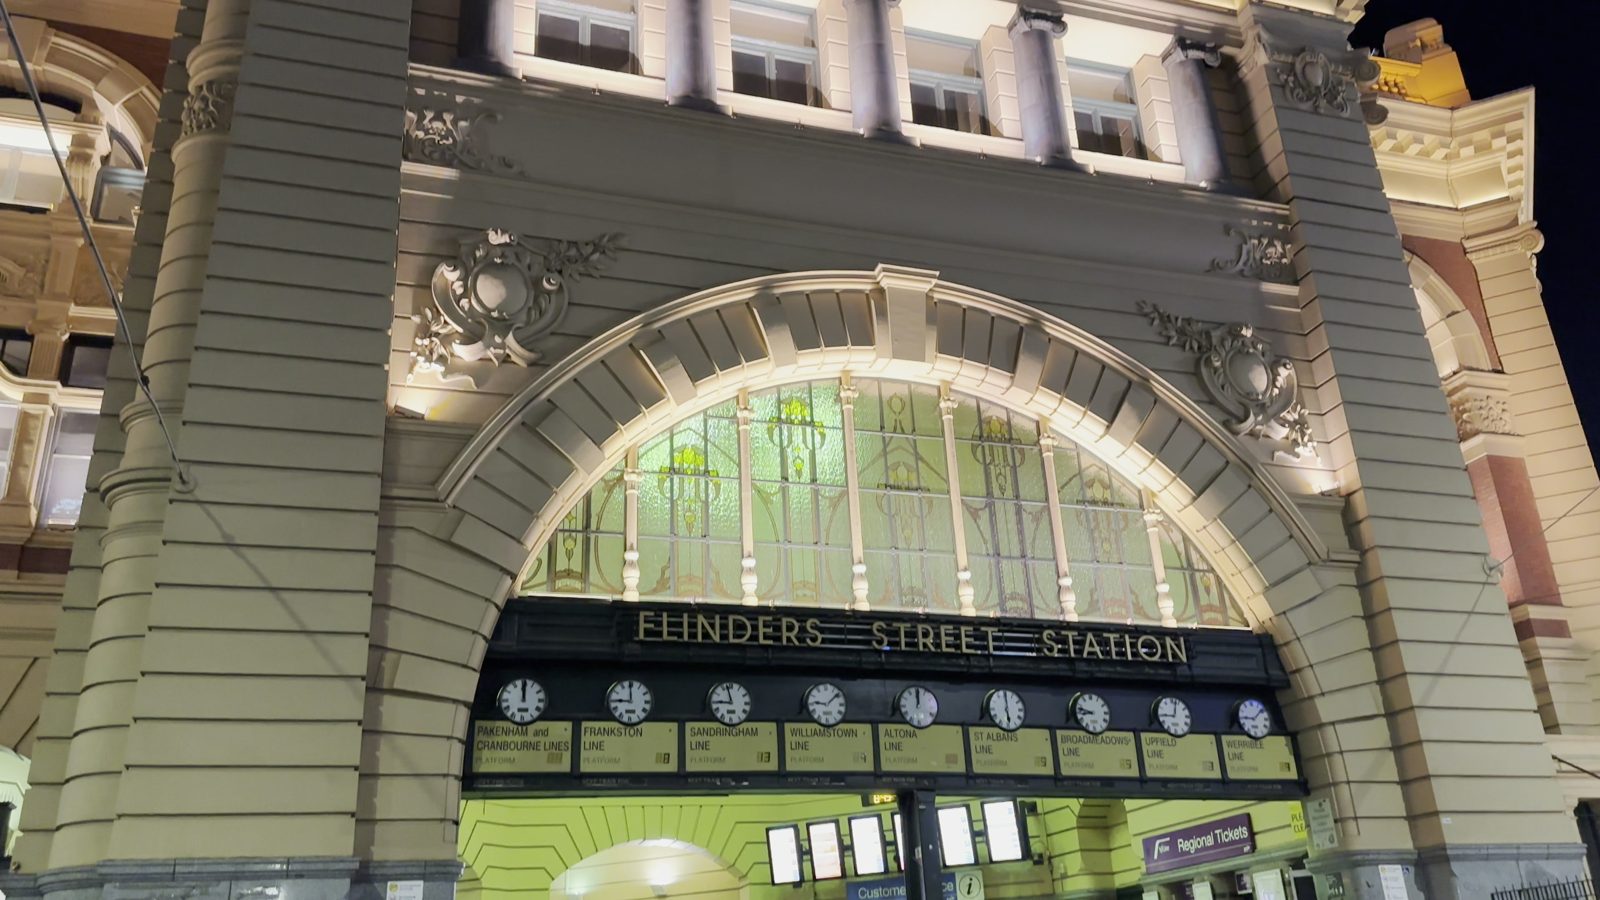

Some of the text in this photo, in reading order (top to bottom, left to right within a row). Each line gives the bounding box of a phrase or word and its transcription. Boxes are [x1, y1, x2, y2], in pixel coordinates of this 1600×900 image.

[638, 611, 1188, 663] FLINDERS STREET STATION
[477, 726, 549, 737] PAKENHAM and
[583, 726, 643, 738] FRANKSTON
[690, 727, 759, 737] SANDRINGHAM
[789, 728, 858, 738] WILLIAMSTOWN
[884, 728, 918, 739] ALTONA
[974, 731, 1018, 742] ST ALBANS
[583, 740, 605, 750] LINE
[1060, 734, 1129, 746] BROADMEADOWS
[1144, 737, 1177, 747] UPFIELD
[1225, 740, 1264, 749] WERRIBEE
[476, 741, 570, 751] CRANBOURNE LINES
[690, 740, 711, 751] LINE
[789, 741, 810, 751] LINE
[884, 742, 904, 752] LINE
[974, 745, 994, 755] LINE
[1062, 747, 1080, 757] LINE
[1146, 749, 1164, 759] LINE
[1227, 751, 1245, 761] LINE
[1177, 831, 1214, 854] Regional
[1214, 825, 1248, 843] Tickets
[858, 885, 907, 900] Custome
